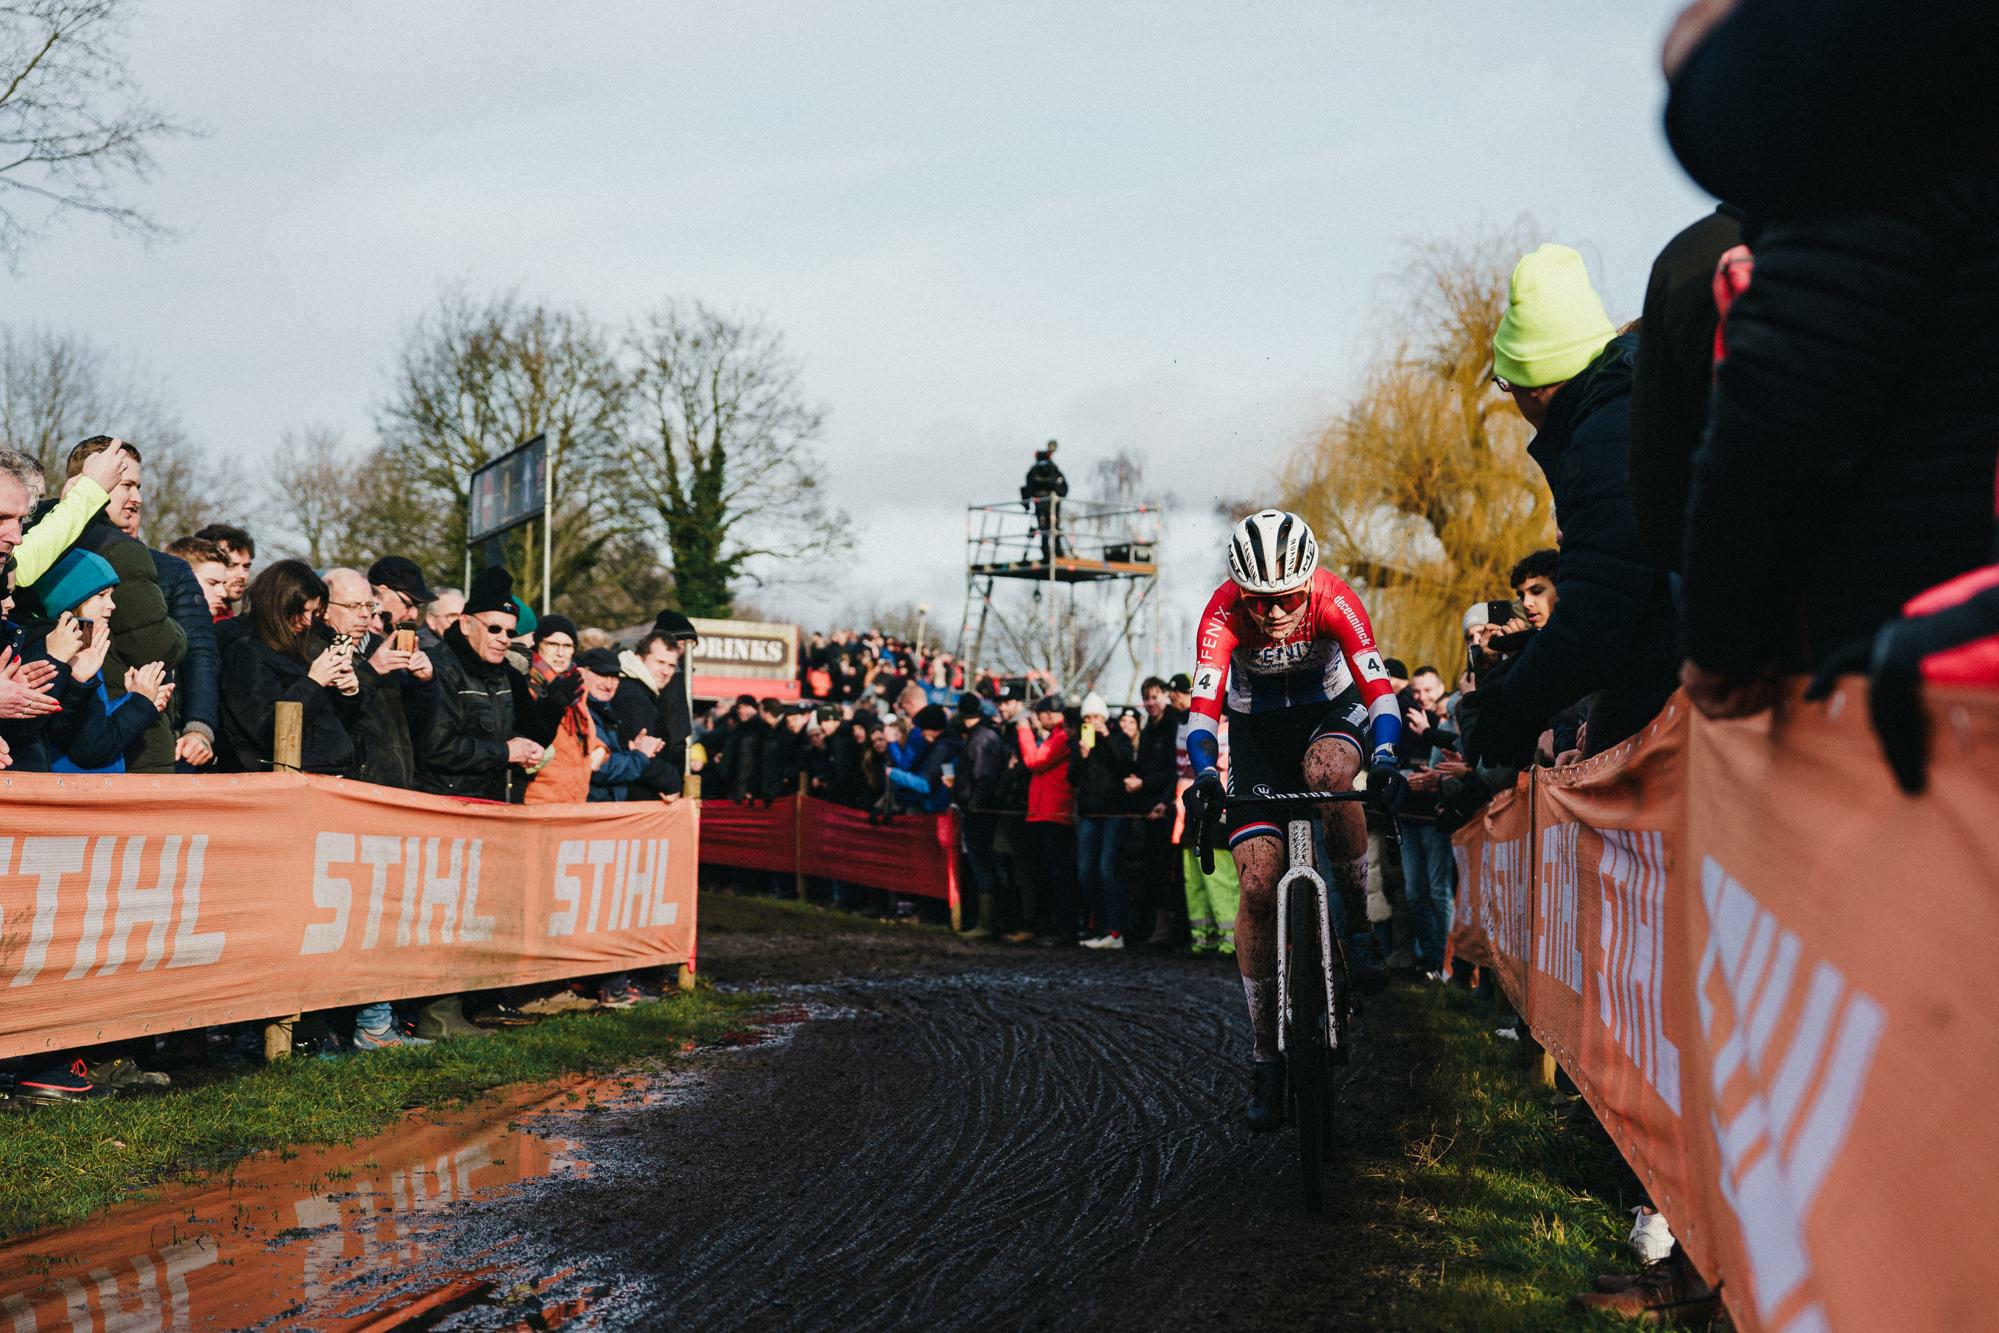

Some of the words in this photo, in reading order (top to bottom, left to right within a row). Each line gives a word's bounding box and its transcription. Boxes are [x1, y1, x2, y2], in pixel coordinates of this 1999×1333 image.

[692, 636, 783, 662] DRINKS
[1200, 604, 1231, 661] FENIX
[1334, 595, 1371, 647] deceuninck
[1198, 673, 1211, 690] 4
[1367, 657, 1381, 673] 4
[0, 835, 225, 988] TIHL
[300, 831, 497, 955] STIHL
[547, 838, 679, 937] STIHL
[1537, 822, 1583, 996] STIHL
[1593, 828, 1682, 1119] STIHL
